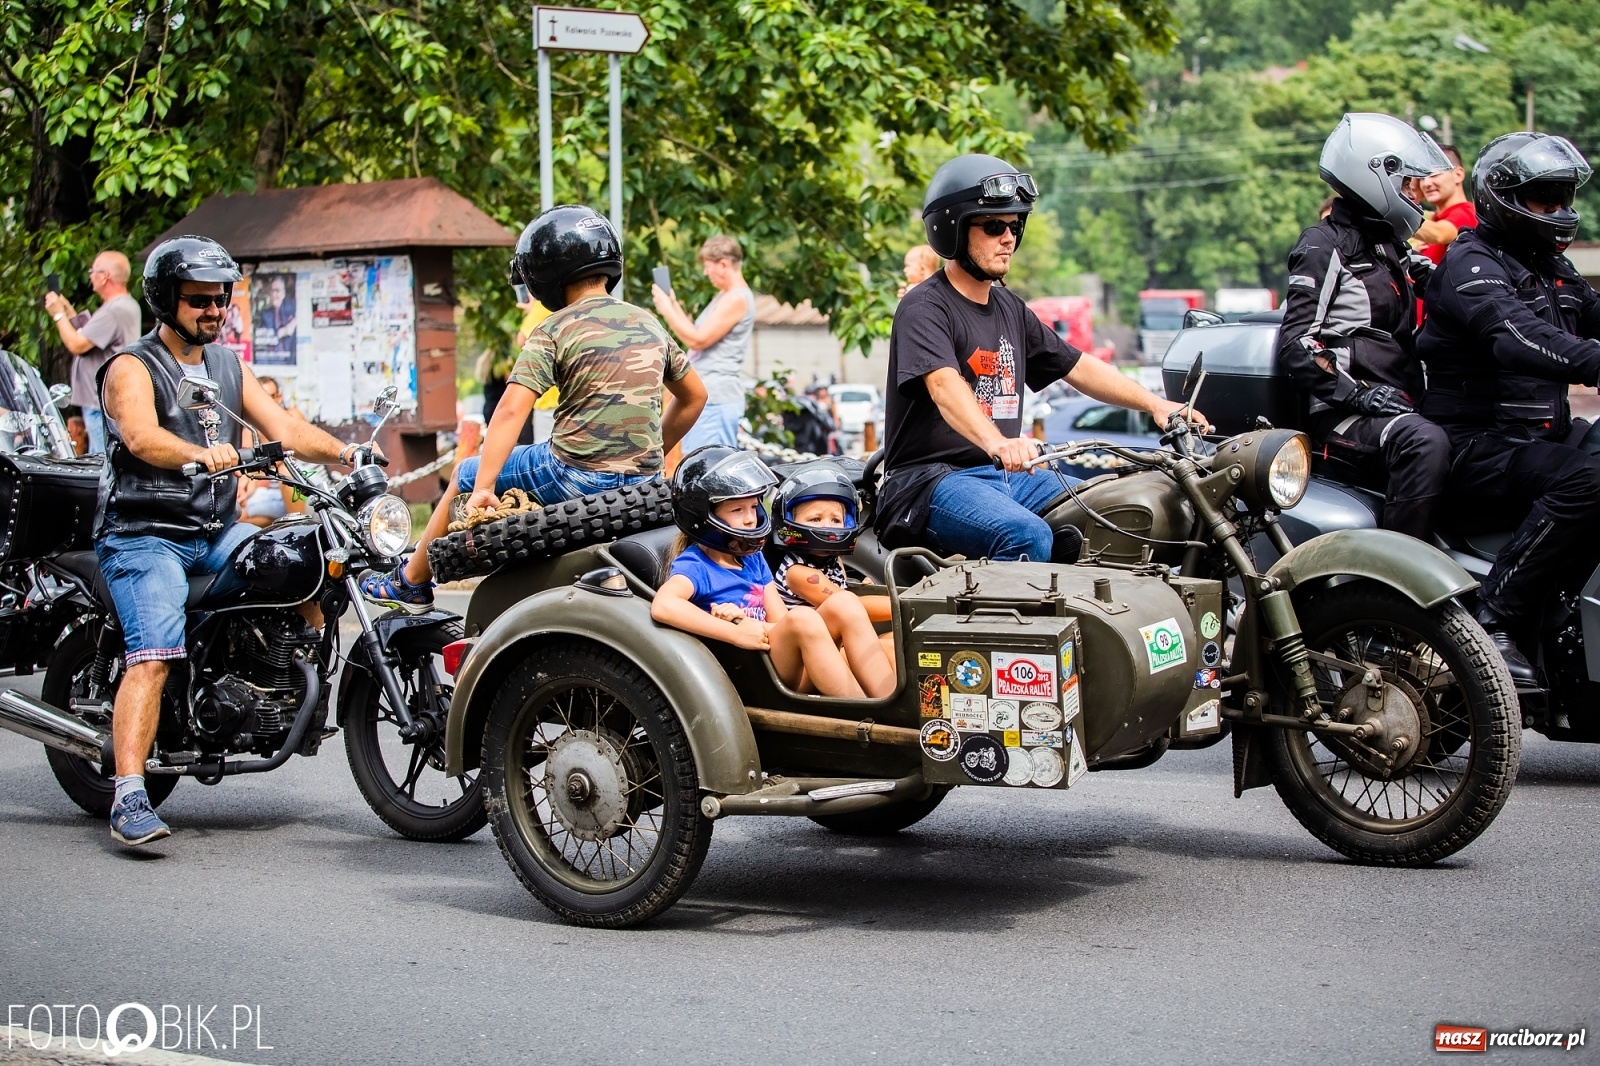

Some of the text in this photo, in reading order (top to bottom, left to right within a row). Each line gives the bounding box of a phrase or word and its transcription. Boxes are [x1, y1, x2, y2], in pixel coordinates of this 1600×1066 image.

[1014, 666, 1034, 680] 106
[1037, 672, 1049, 682] 2012
[1029, 680, 1052, 697] RALLYE
